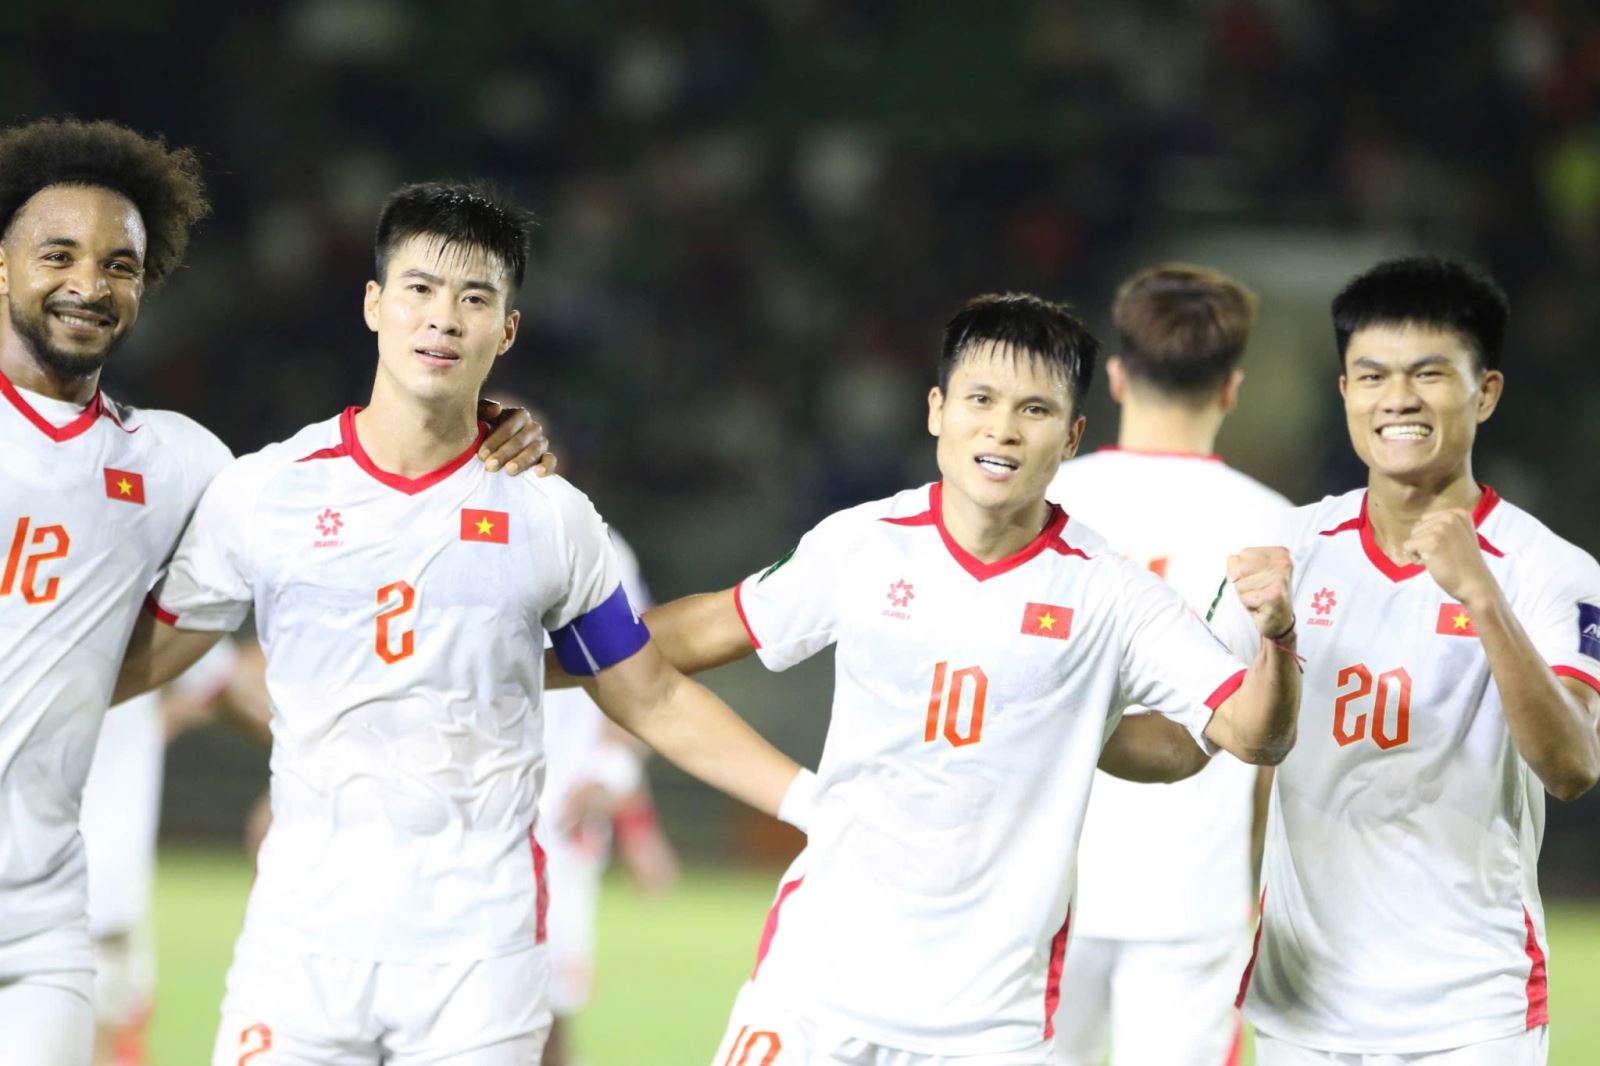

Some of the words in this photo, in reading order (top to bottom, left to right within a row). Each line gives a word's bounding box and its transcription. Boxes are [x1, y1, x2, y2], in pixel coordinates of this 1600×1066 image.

[0, 515, 70, 605] 12
[375, 579, 415, 666] 2
[924, 660, 989, 748] 10
[1332, 662, 1412, 751] 20
